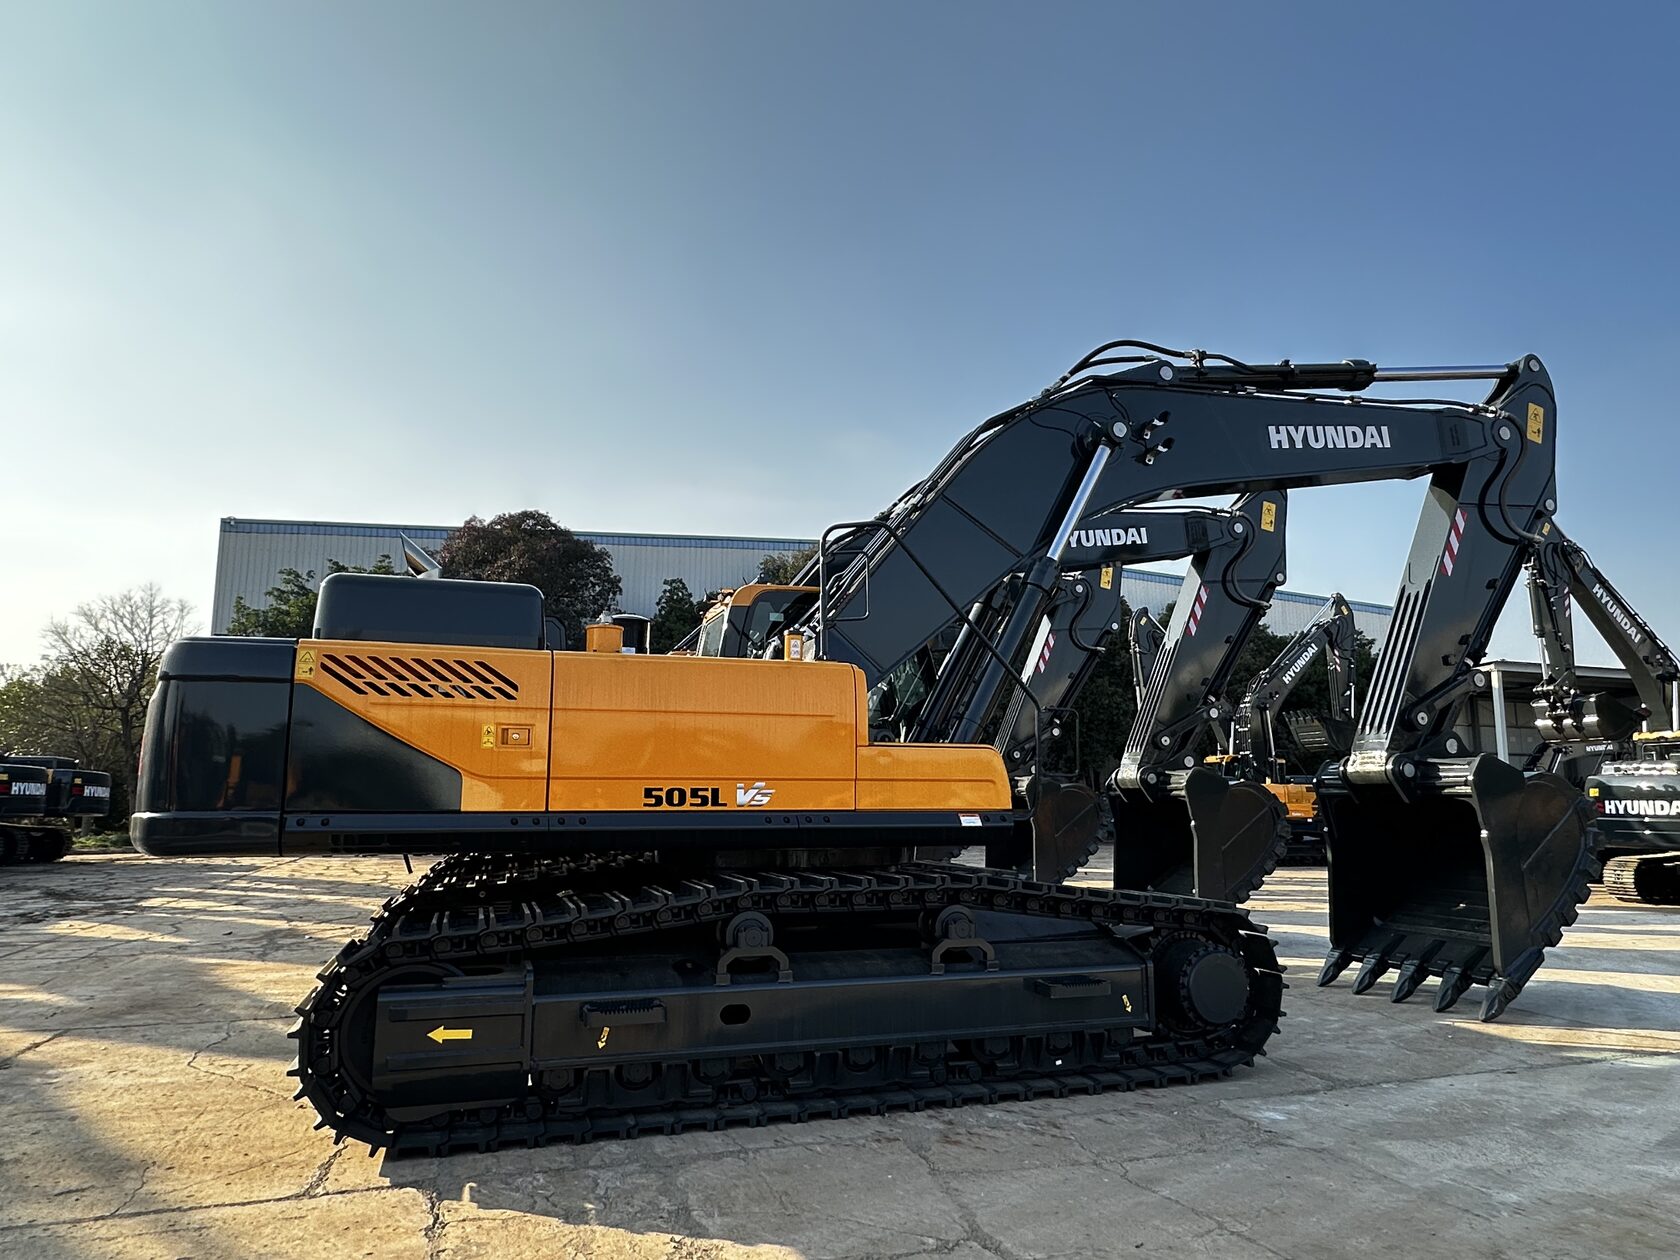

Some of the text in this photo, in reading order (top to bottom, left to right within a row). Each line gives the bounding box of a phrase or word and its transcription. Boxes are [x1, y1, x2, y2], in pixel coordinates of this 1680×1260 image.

[1267, 425, 1391, 449] HYUNDAI
[1069, 527, 1148, 548] YUNDAI
[1592, 583, 1641, 643] HYUNDAI
[1282, 643, 1318, 685] HYUNDAI
[642, 787, 728, 807] 505L
[1604, 799, 1680, 816] HYUNDA
